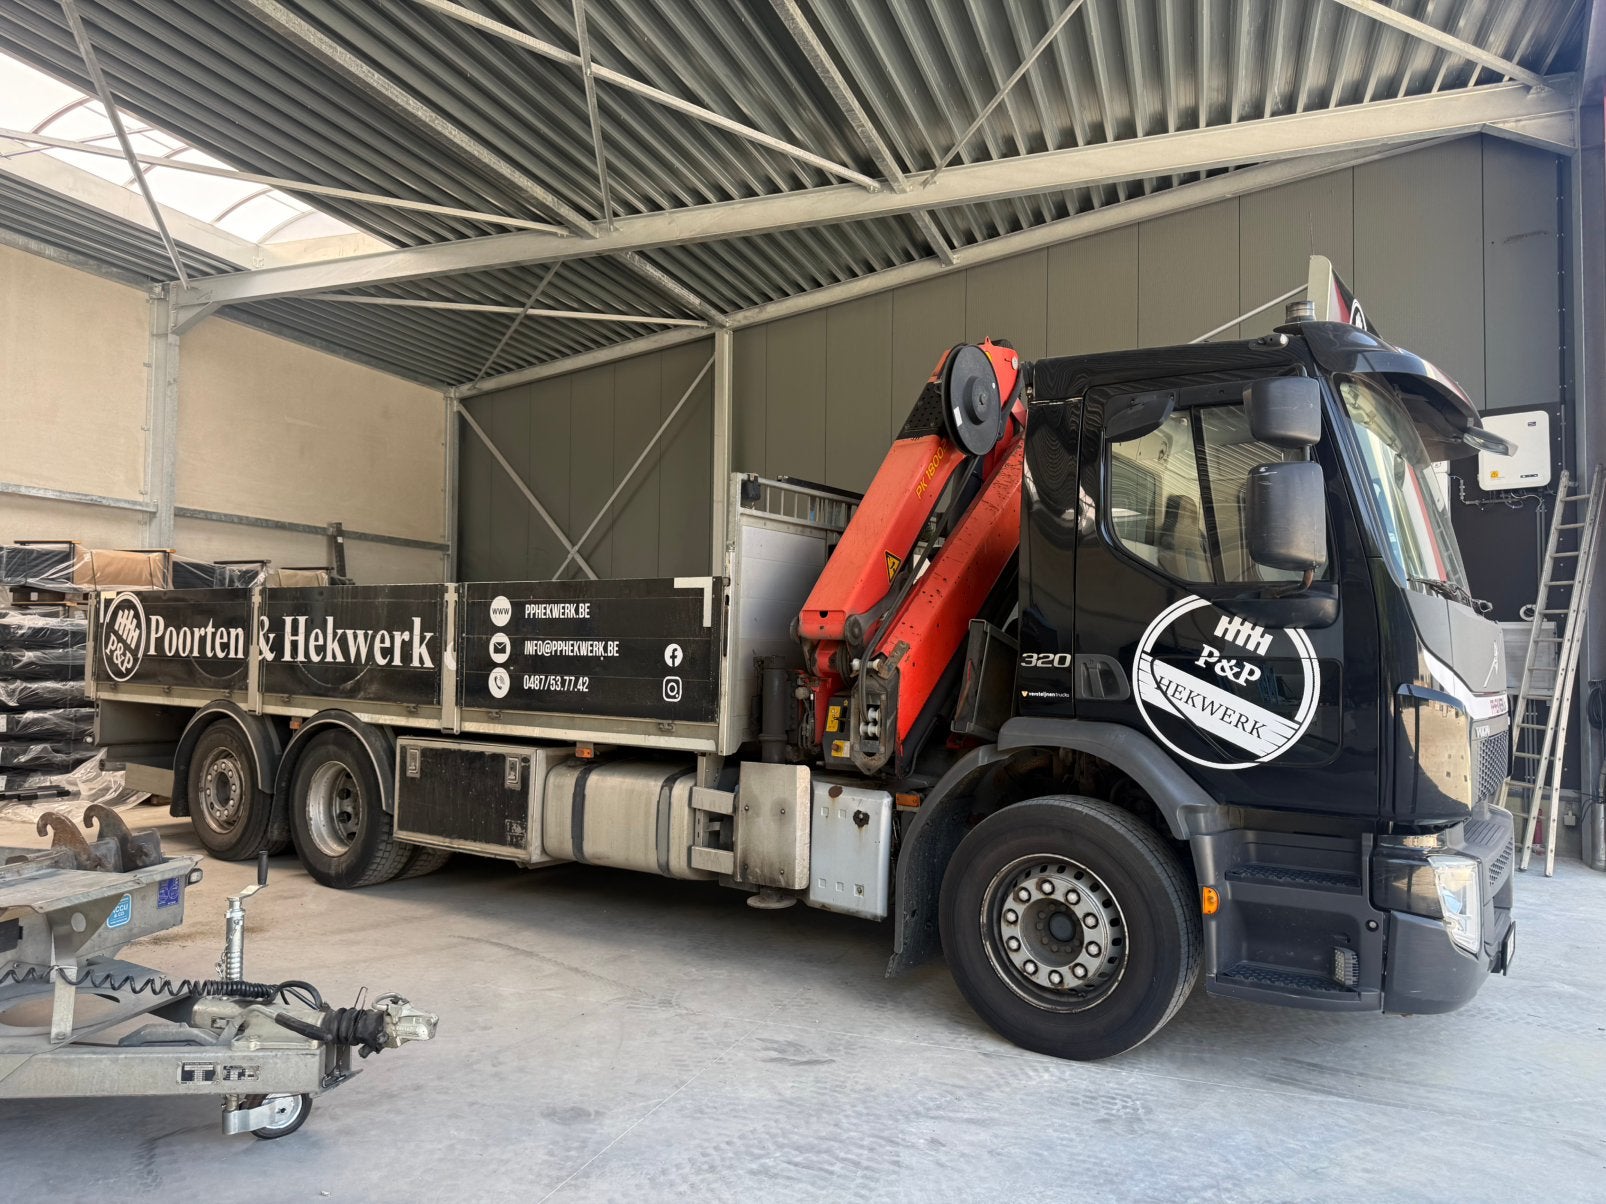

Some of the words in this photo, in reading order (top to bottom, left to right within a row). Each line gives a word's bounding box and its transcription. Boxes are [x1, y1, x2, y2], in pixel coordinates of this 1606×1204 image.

[916, 477, 928, 500] PK
[525, 603, 591, 619] PPHEKWERK.BE
[147, 615, 245, 659] Poorten
[258, 616, 277, 662] &
[281, 616, 435, 668] Hekwerk
[524, 640, 620, 657] INFO@PPHEKWERK.BE
[105, 633, 133, 674] P&P
[1020, 652, 1072, 668] 320
[1194, 643, 1262, 687] P&P
[523, 675, 589, 692] 0487/53.77.42
[1154, 675, 1268, 740] HEKWERK
[113, 903, 129, 914] CCU
